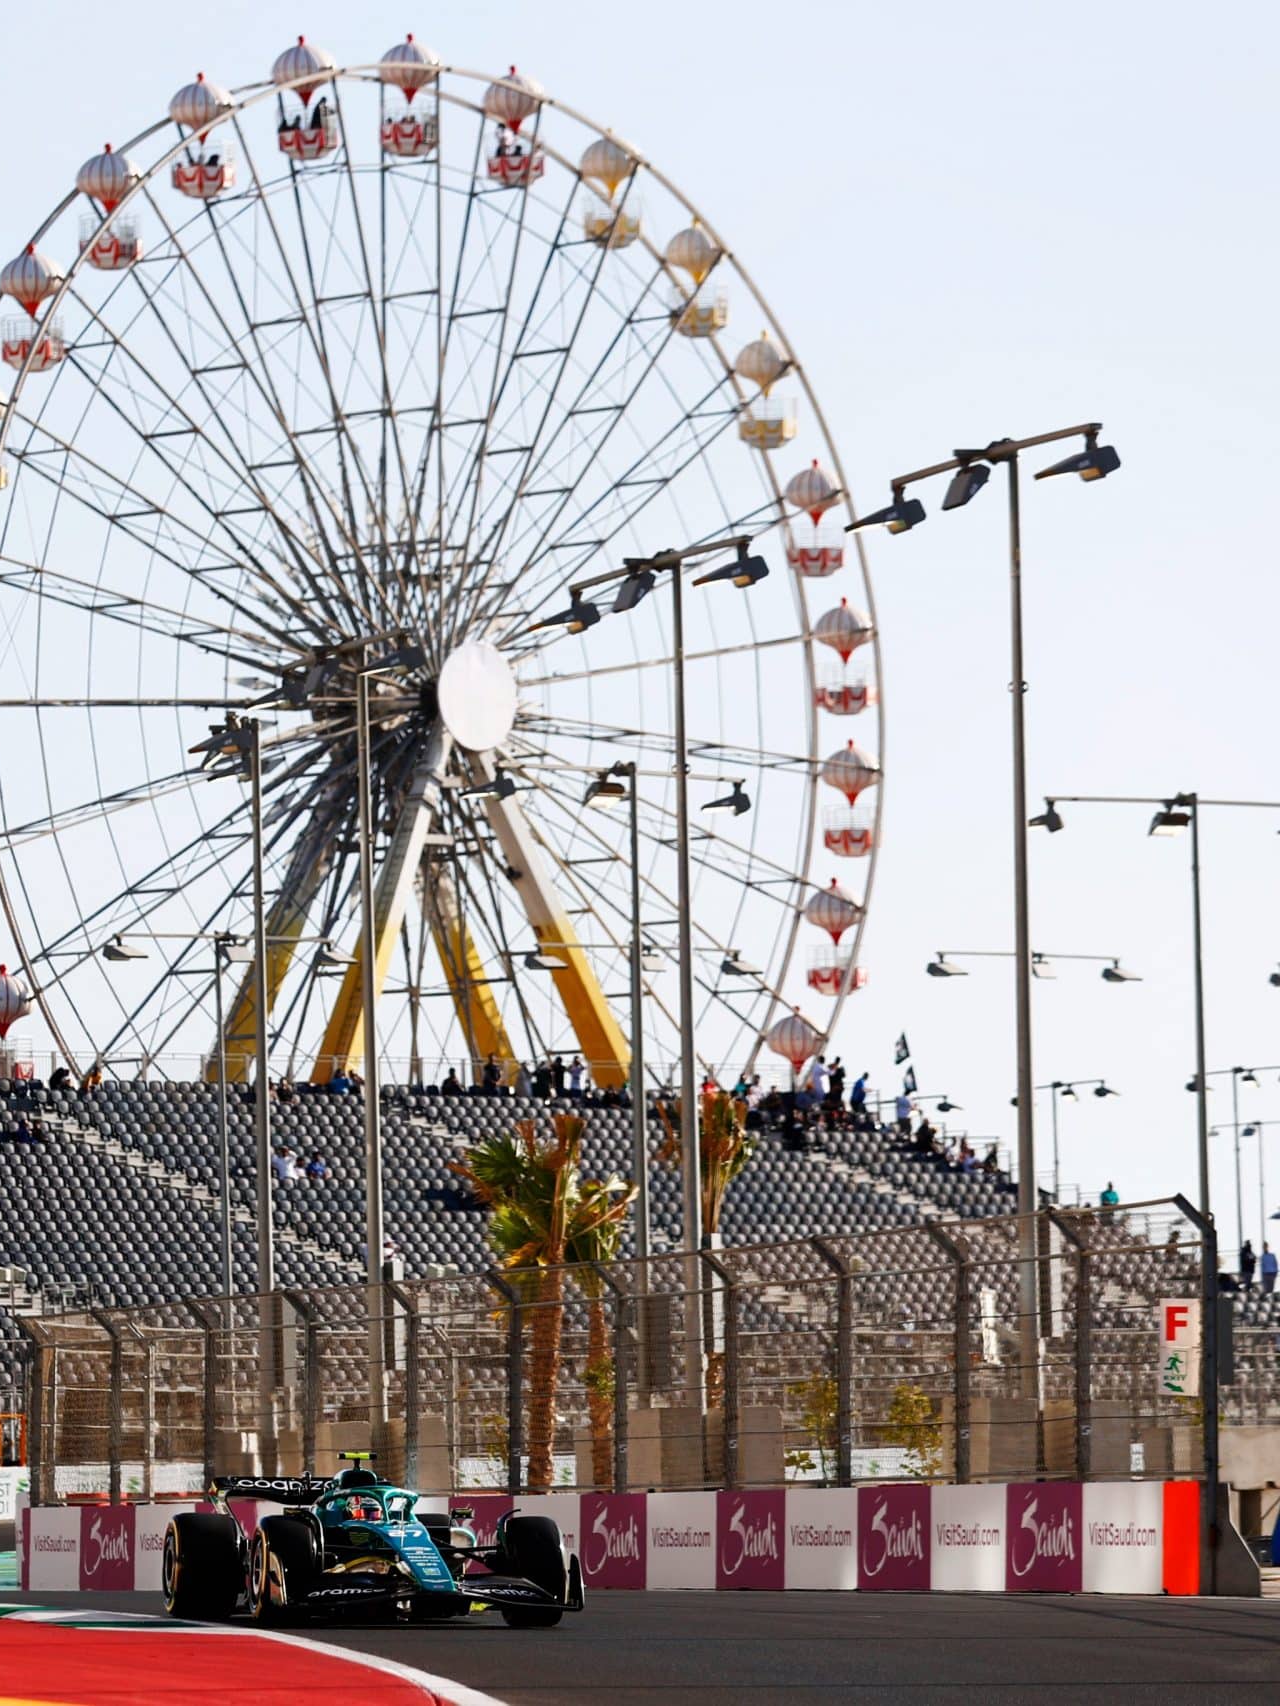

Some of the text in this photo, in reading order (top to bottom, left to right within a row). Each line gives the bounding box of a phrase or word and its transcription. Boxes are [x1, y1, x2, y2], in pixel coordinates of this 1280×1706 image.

[1166, 1306, 1189, 1341] F
[1163, 1374, 1188, 1382] EXIT
[34, 1534, 77, 1553] VisitSaudi.com
[84, 1512, 130, 1575] Saudi
[584, 1501, 640, 1575] Saudi
[651, 1527, 711, 1549] VisitSaudi.com
[721, 1498, 778, 1575] Saudi
[790, 1524, 852, 1547] VisitSaudi.com
[862, 1495, 924, 1576] Saudi
[936, 1522, 1000, 1547] VisitSaudi.com
[1011, 1491, 1075, 1576] Saudi
[1088, 1521, 1156, 1547] VisitSaudi.com
